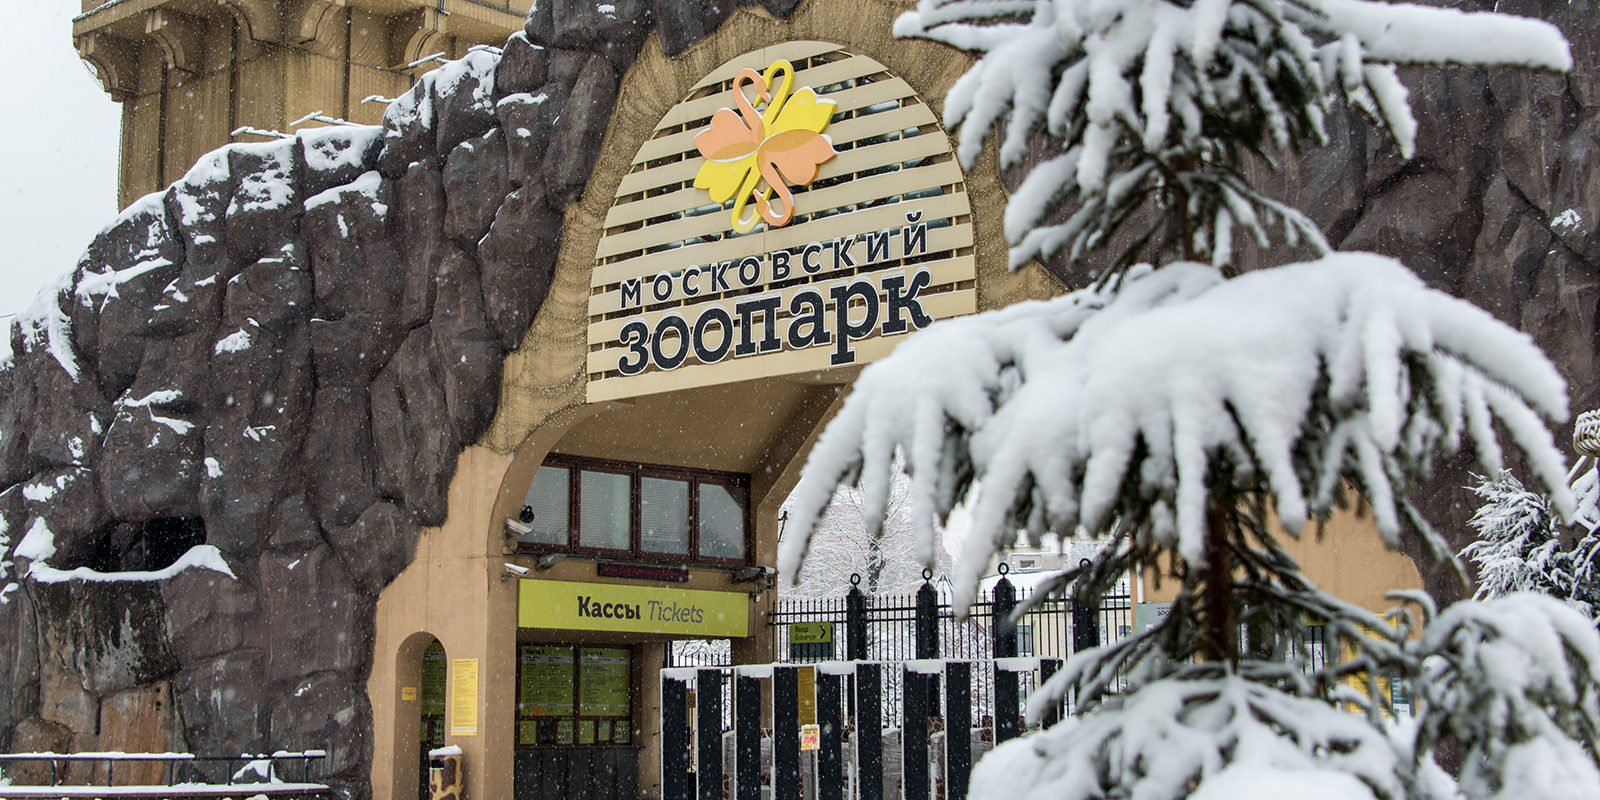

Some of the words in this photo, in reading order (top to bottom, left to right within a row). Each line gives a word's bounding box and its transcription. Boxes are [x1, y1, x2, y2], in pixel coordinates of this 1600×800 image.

[620, 209, 929, 309] МОСКОВСКИЙ
[577, 595, 641, 620] Кассы
[647, 600, 704, 624] Tickets
